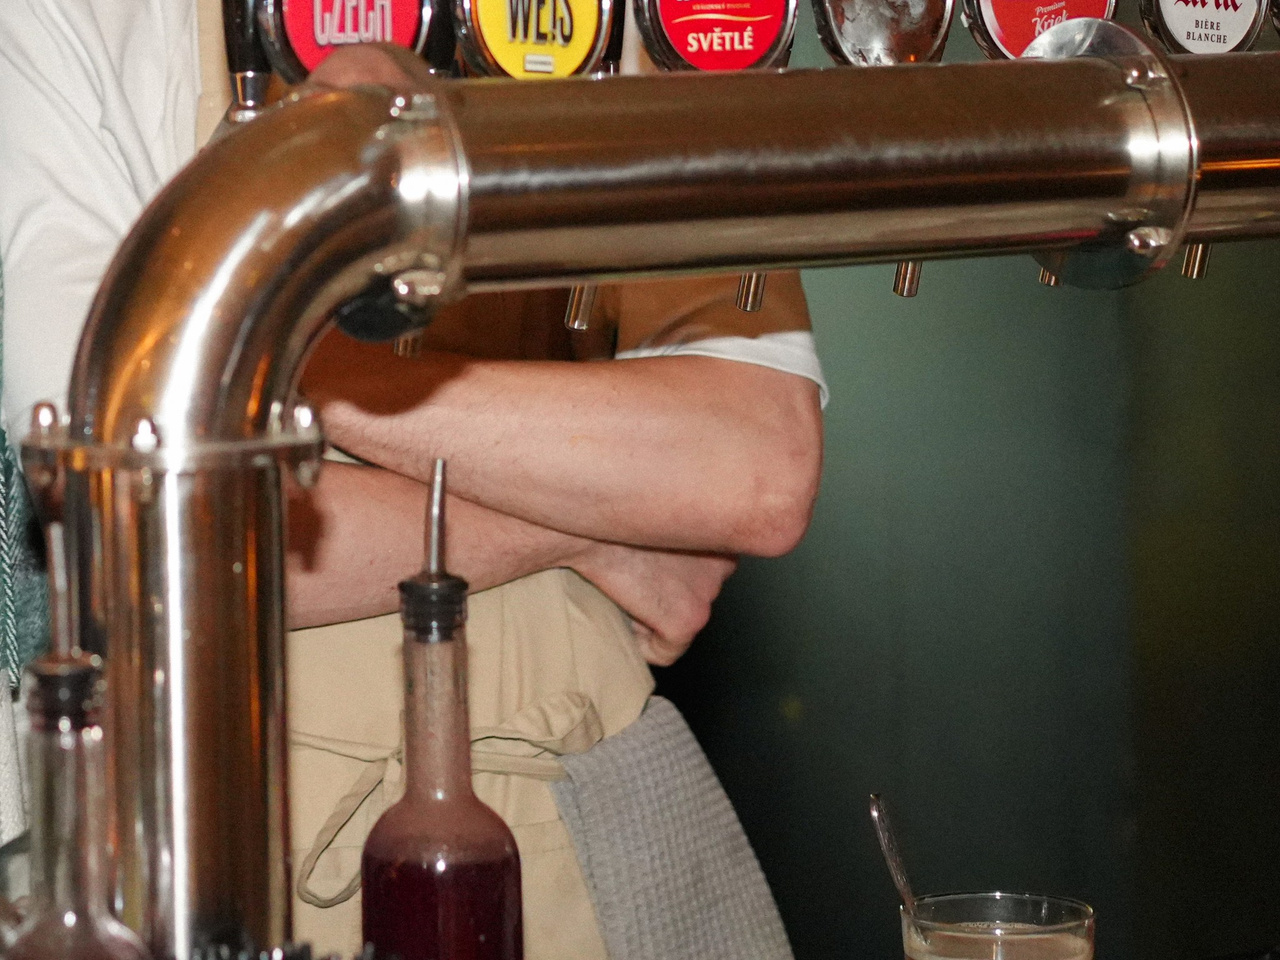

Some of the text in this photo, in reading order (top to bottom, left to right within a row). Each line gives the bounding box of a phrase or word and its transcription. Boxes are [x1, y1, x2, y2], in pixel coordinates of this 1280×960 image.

[1194, 19, 1221, 31] BIÈRE
[686, 25, 755, 53] SVĚTLÉ
[1185, 31, 1228, 44] BLANCHE
